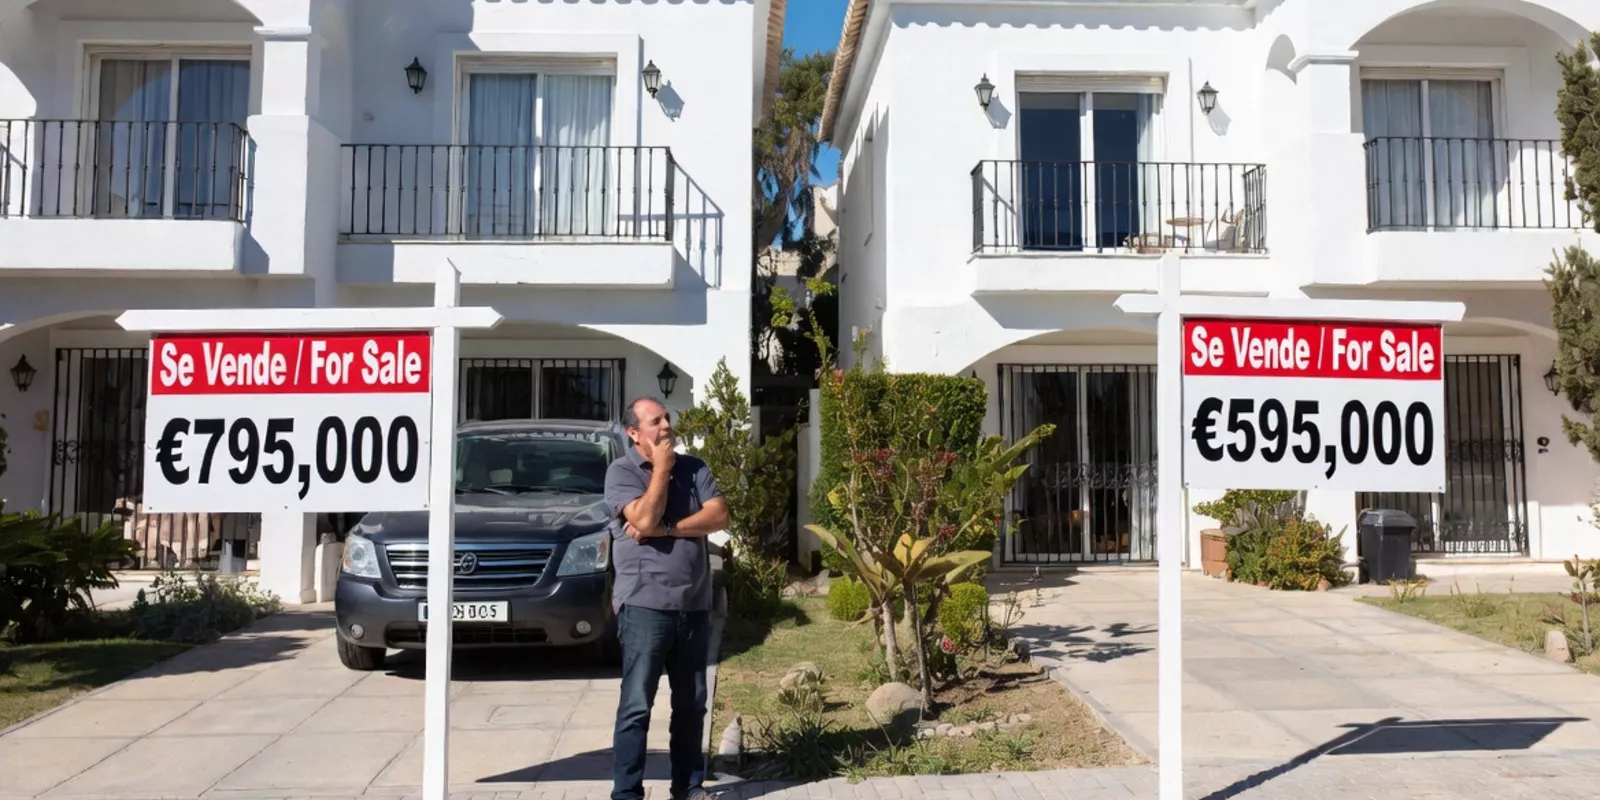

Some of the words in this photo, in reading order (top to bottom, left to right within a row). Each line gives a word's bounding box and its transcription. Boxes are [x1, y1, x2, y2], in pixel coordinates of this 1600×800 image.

[160, 342, 195, 387] Se
[202, 341, 287, 386] Vende
[294, 340, 304, 386] /
[310, 340, 353, 385] For
[361, 339, 422, 385] Sale
[1191, 325, 1224, 368] Se
[1230, 327, 1310, 369] Vende
[1317, 327, 1325, 370] /
[1332, 328, 1373, 371] For
[1379, 330, 1435, 373] Sale
[155, 415, 419, 501] €795,000
[1191, 397, 1434, 480] €595,000
